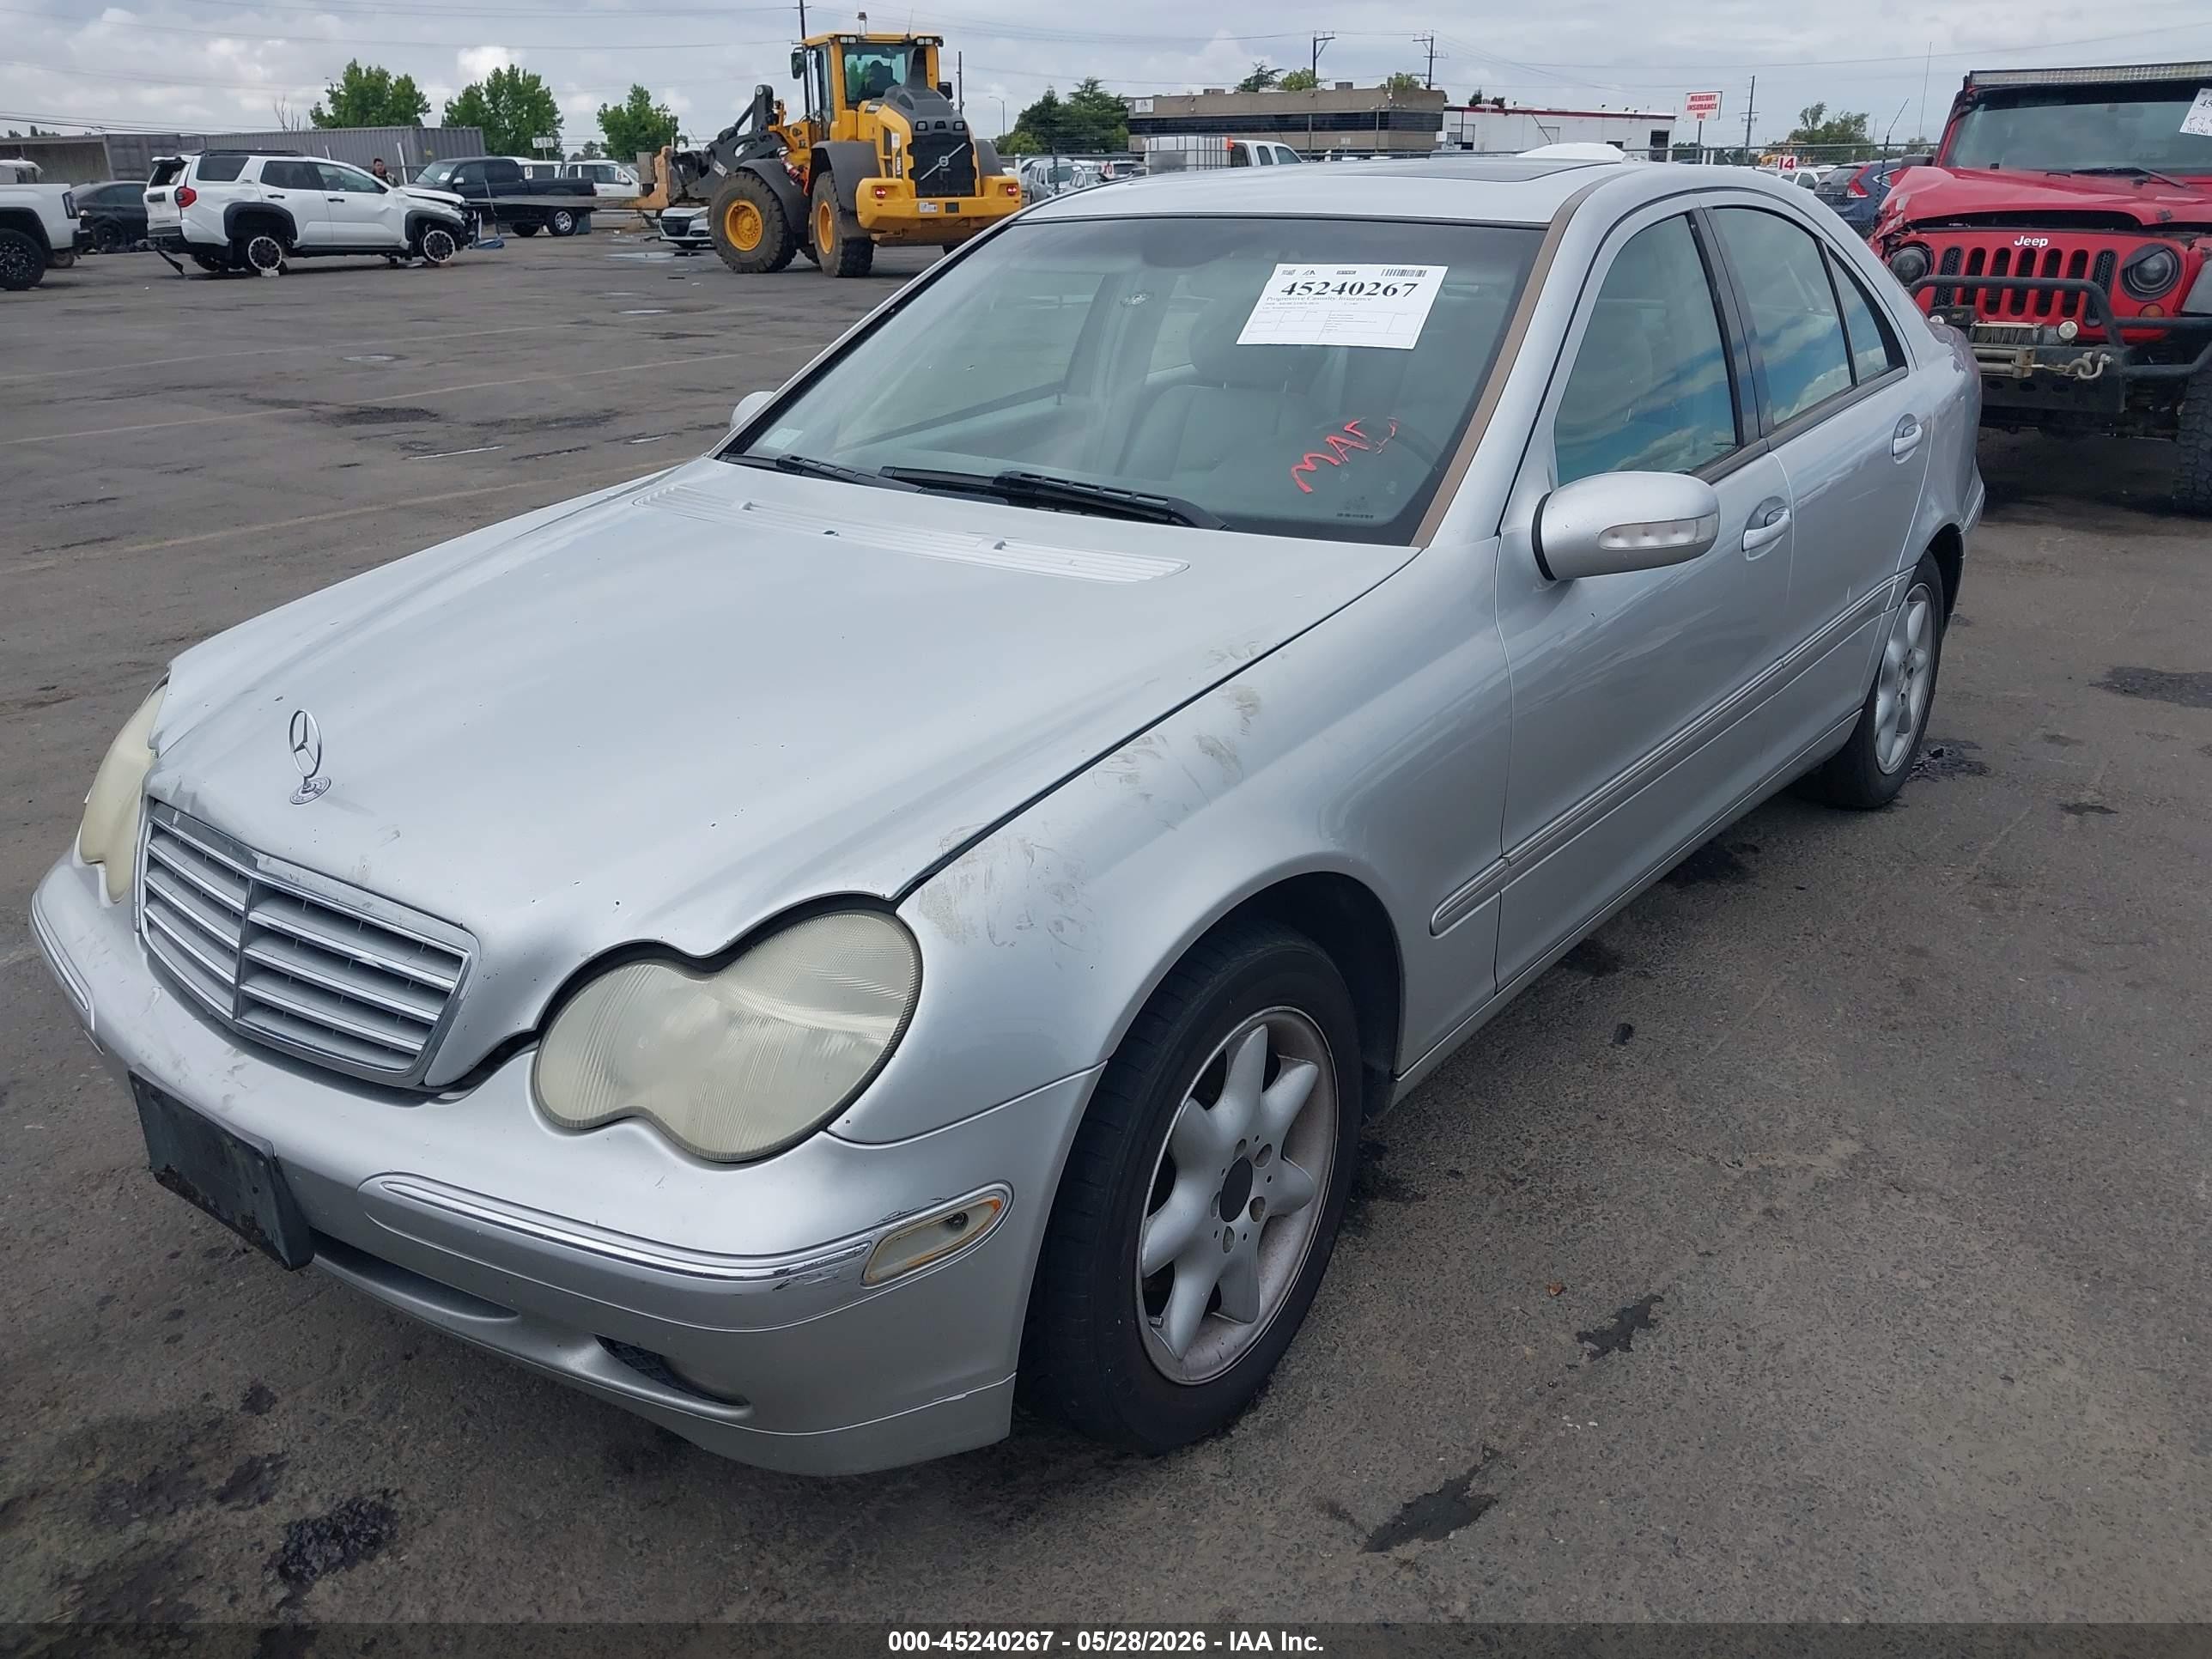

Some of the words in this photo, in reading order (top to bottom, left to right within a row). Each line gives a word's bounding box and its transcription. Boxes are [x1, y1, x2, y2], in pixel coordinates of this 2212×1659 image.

[1779, 157, 1795, 171] 14
[2014, 235, 2049, 248] Jeep
[1280, 281, 1419, 297] 45240267
